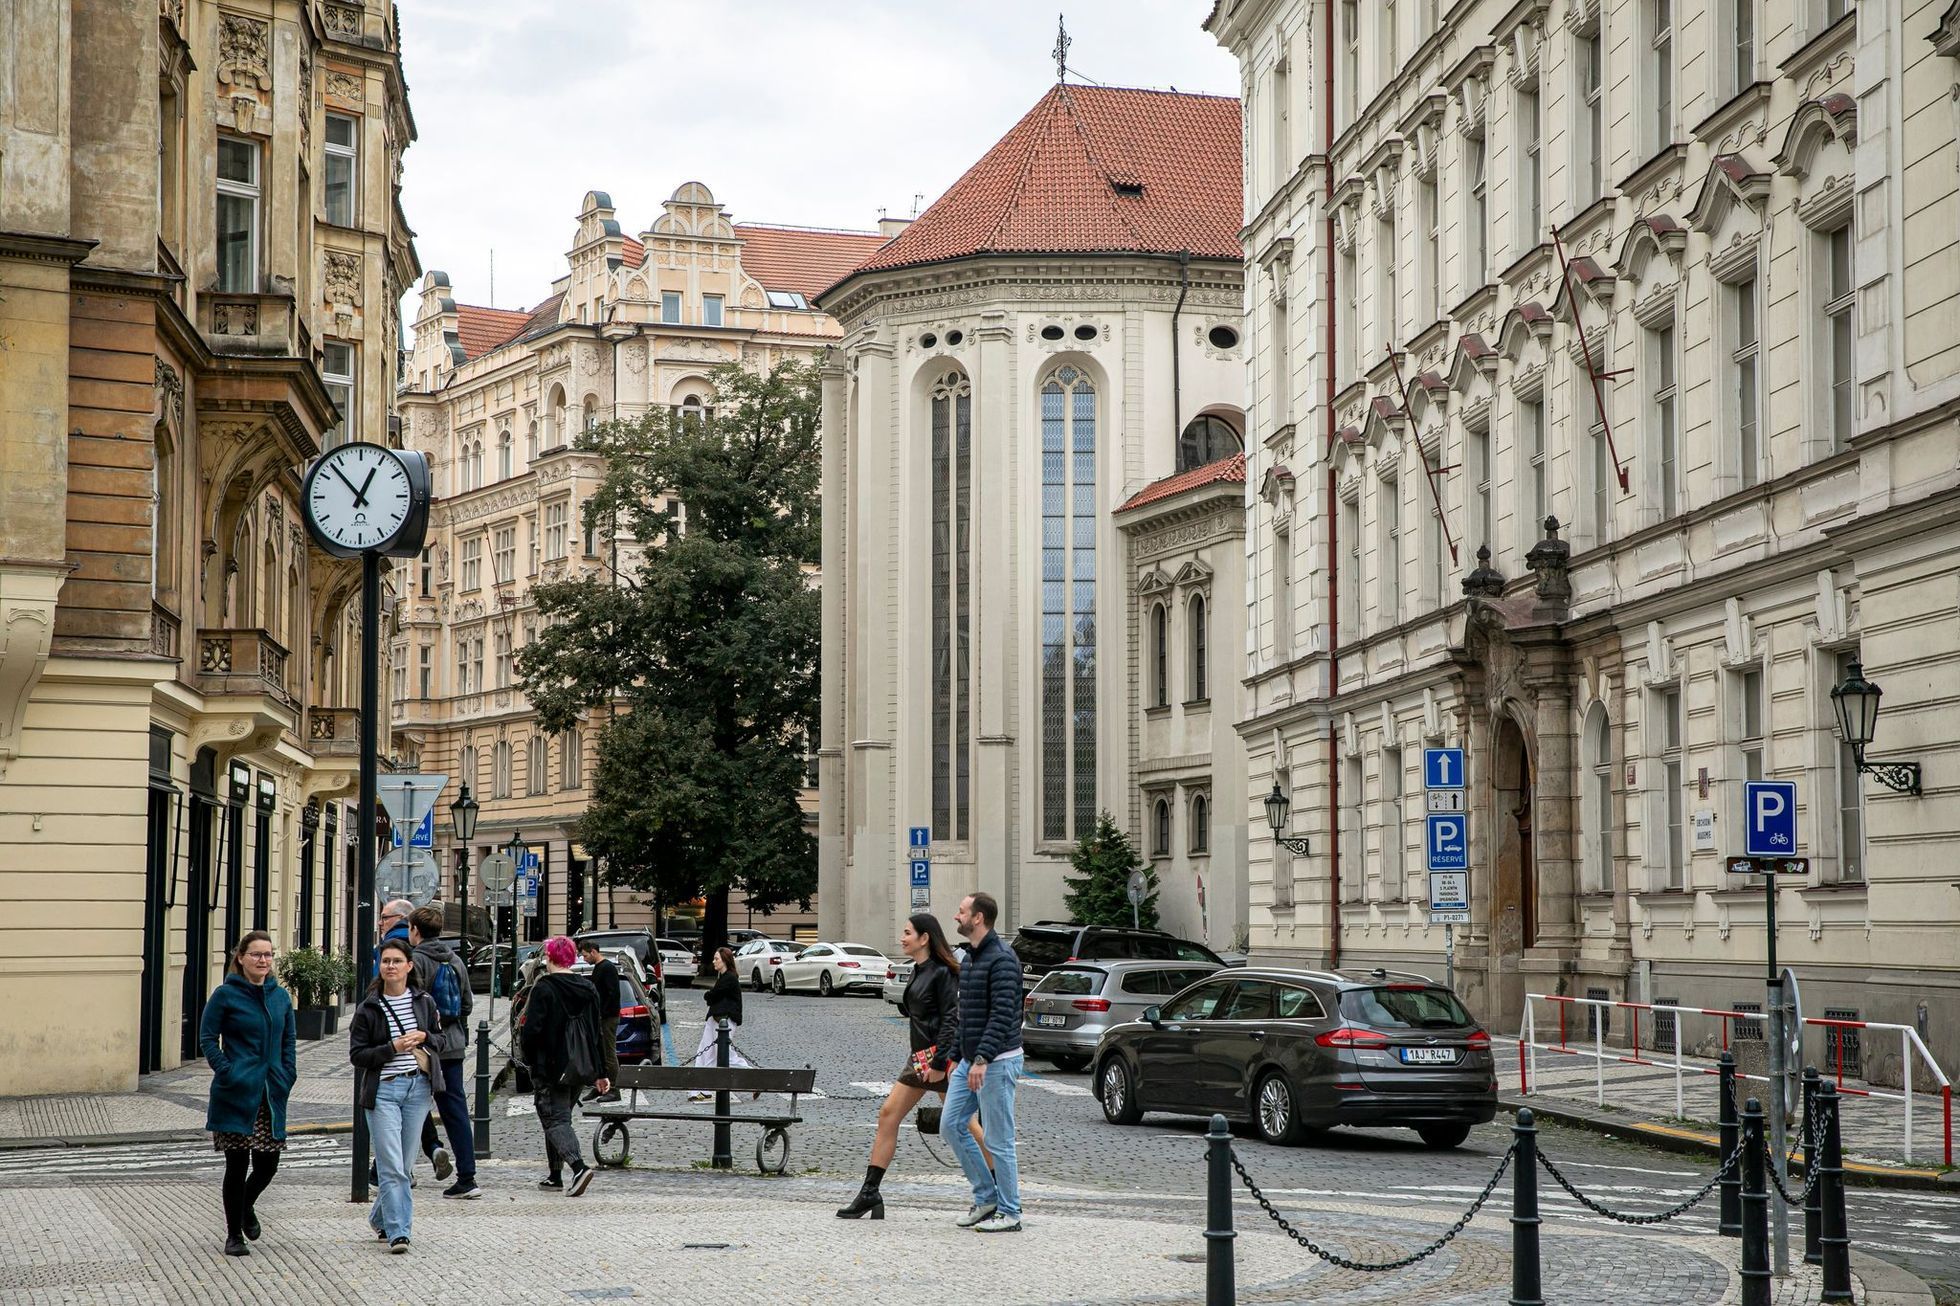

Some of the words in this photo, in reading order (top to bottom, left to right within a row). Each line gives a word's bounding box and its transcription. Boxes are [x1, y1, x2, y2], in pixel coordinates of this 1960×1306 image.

[1757, 791, 1785, 832] P
[1435, 821, 1458, 852] P
[914, 863, 926, 879] P
[1409, 1049, 1425, 1060] 1AJ
[1431, 1049, 1451, 1060] R447
